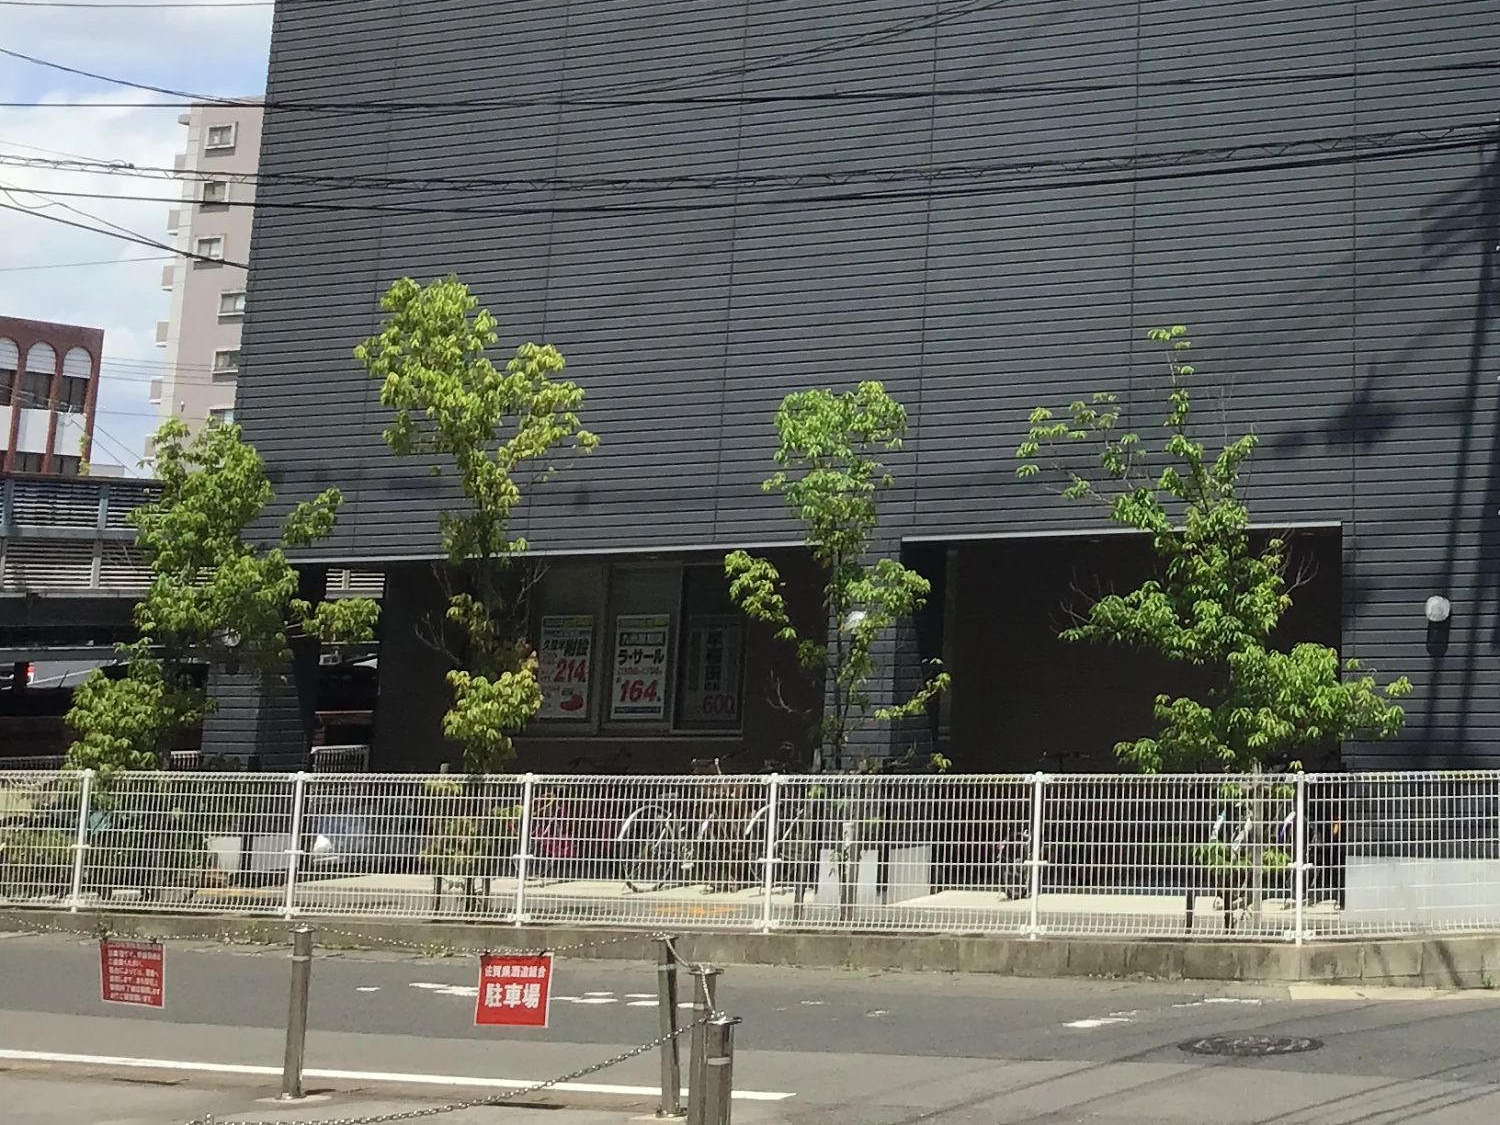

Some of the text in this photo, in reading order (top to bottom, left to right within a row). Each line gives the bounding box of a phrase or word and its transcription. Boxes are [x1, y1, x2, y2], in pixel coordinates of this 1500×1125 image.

[617, 648, 665, 666] ラ・サール
[484, 982, 542, 1009] 駐車場
